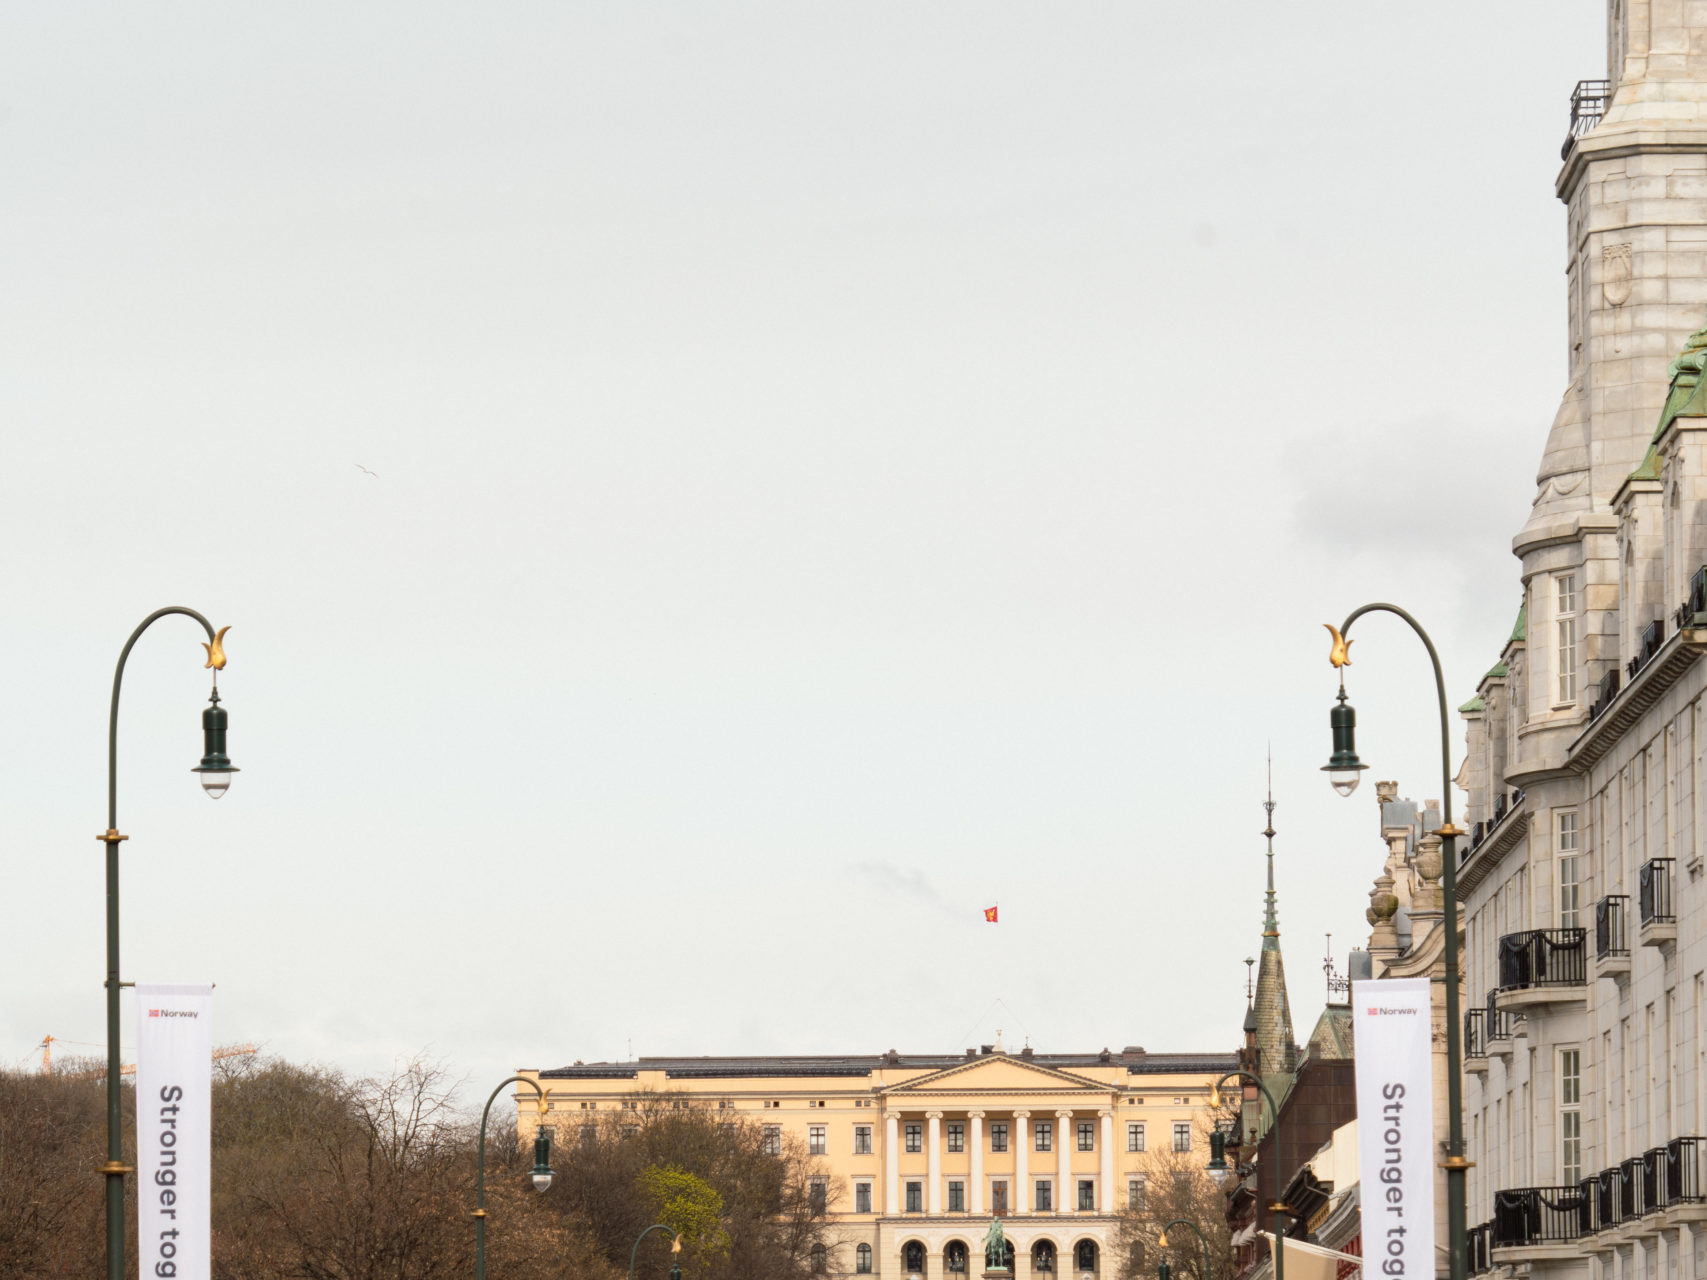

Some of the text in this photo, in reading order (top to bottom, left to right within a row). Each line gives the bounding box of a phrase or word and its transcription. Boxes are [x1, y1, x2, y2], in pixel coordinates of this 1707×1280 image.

[160, 1009, 198, 1019] Norway
[1379, 1007, 1418, 1016] Norway
[154, 1085, 183, 1220] Stronger
[1379, 1082, 1406, 1218] Stronger
